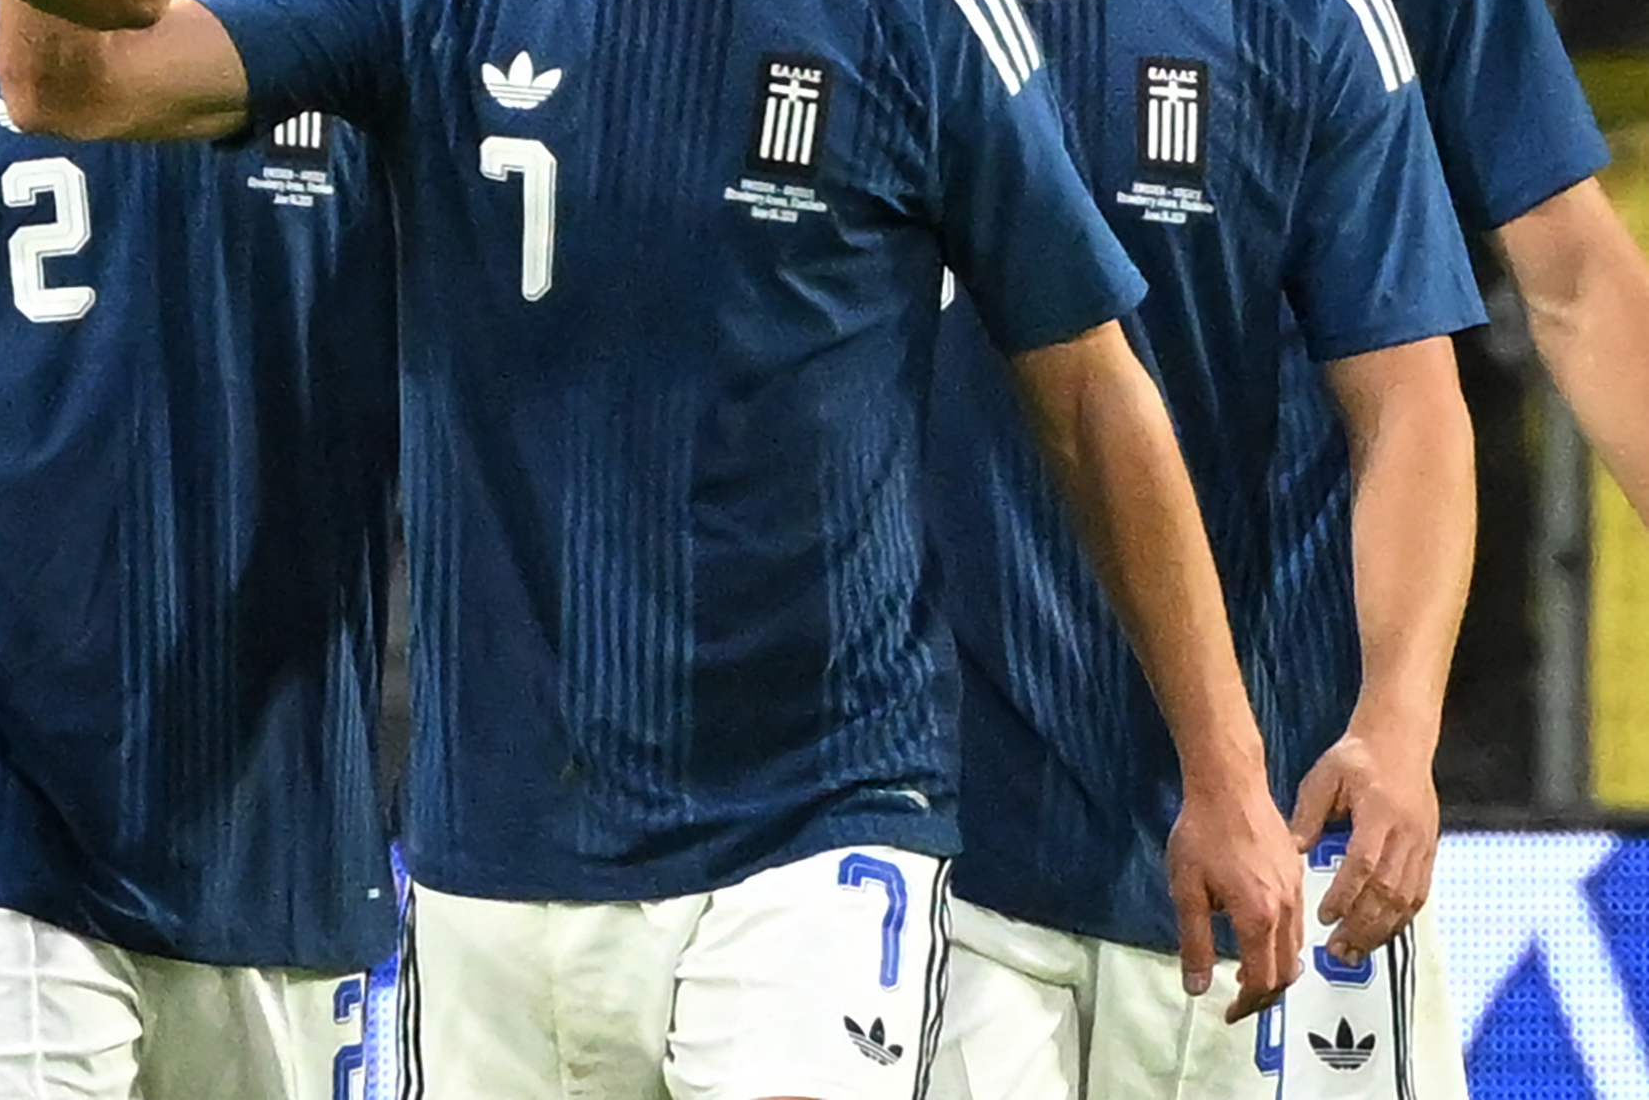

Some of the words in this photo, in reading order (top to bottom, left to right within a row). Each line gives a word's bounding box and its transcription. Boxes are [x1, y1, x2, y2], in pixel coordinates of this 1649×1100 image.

[1, 157, 96, 323] 2
[480, 136, 557, 302] 7
[837, 852, 909, 990] 7
